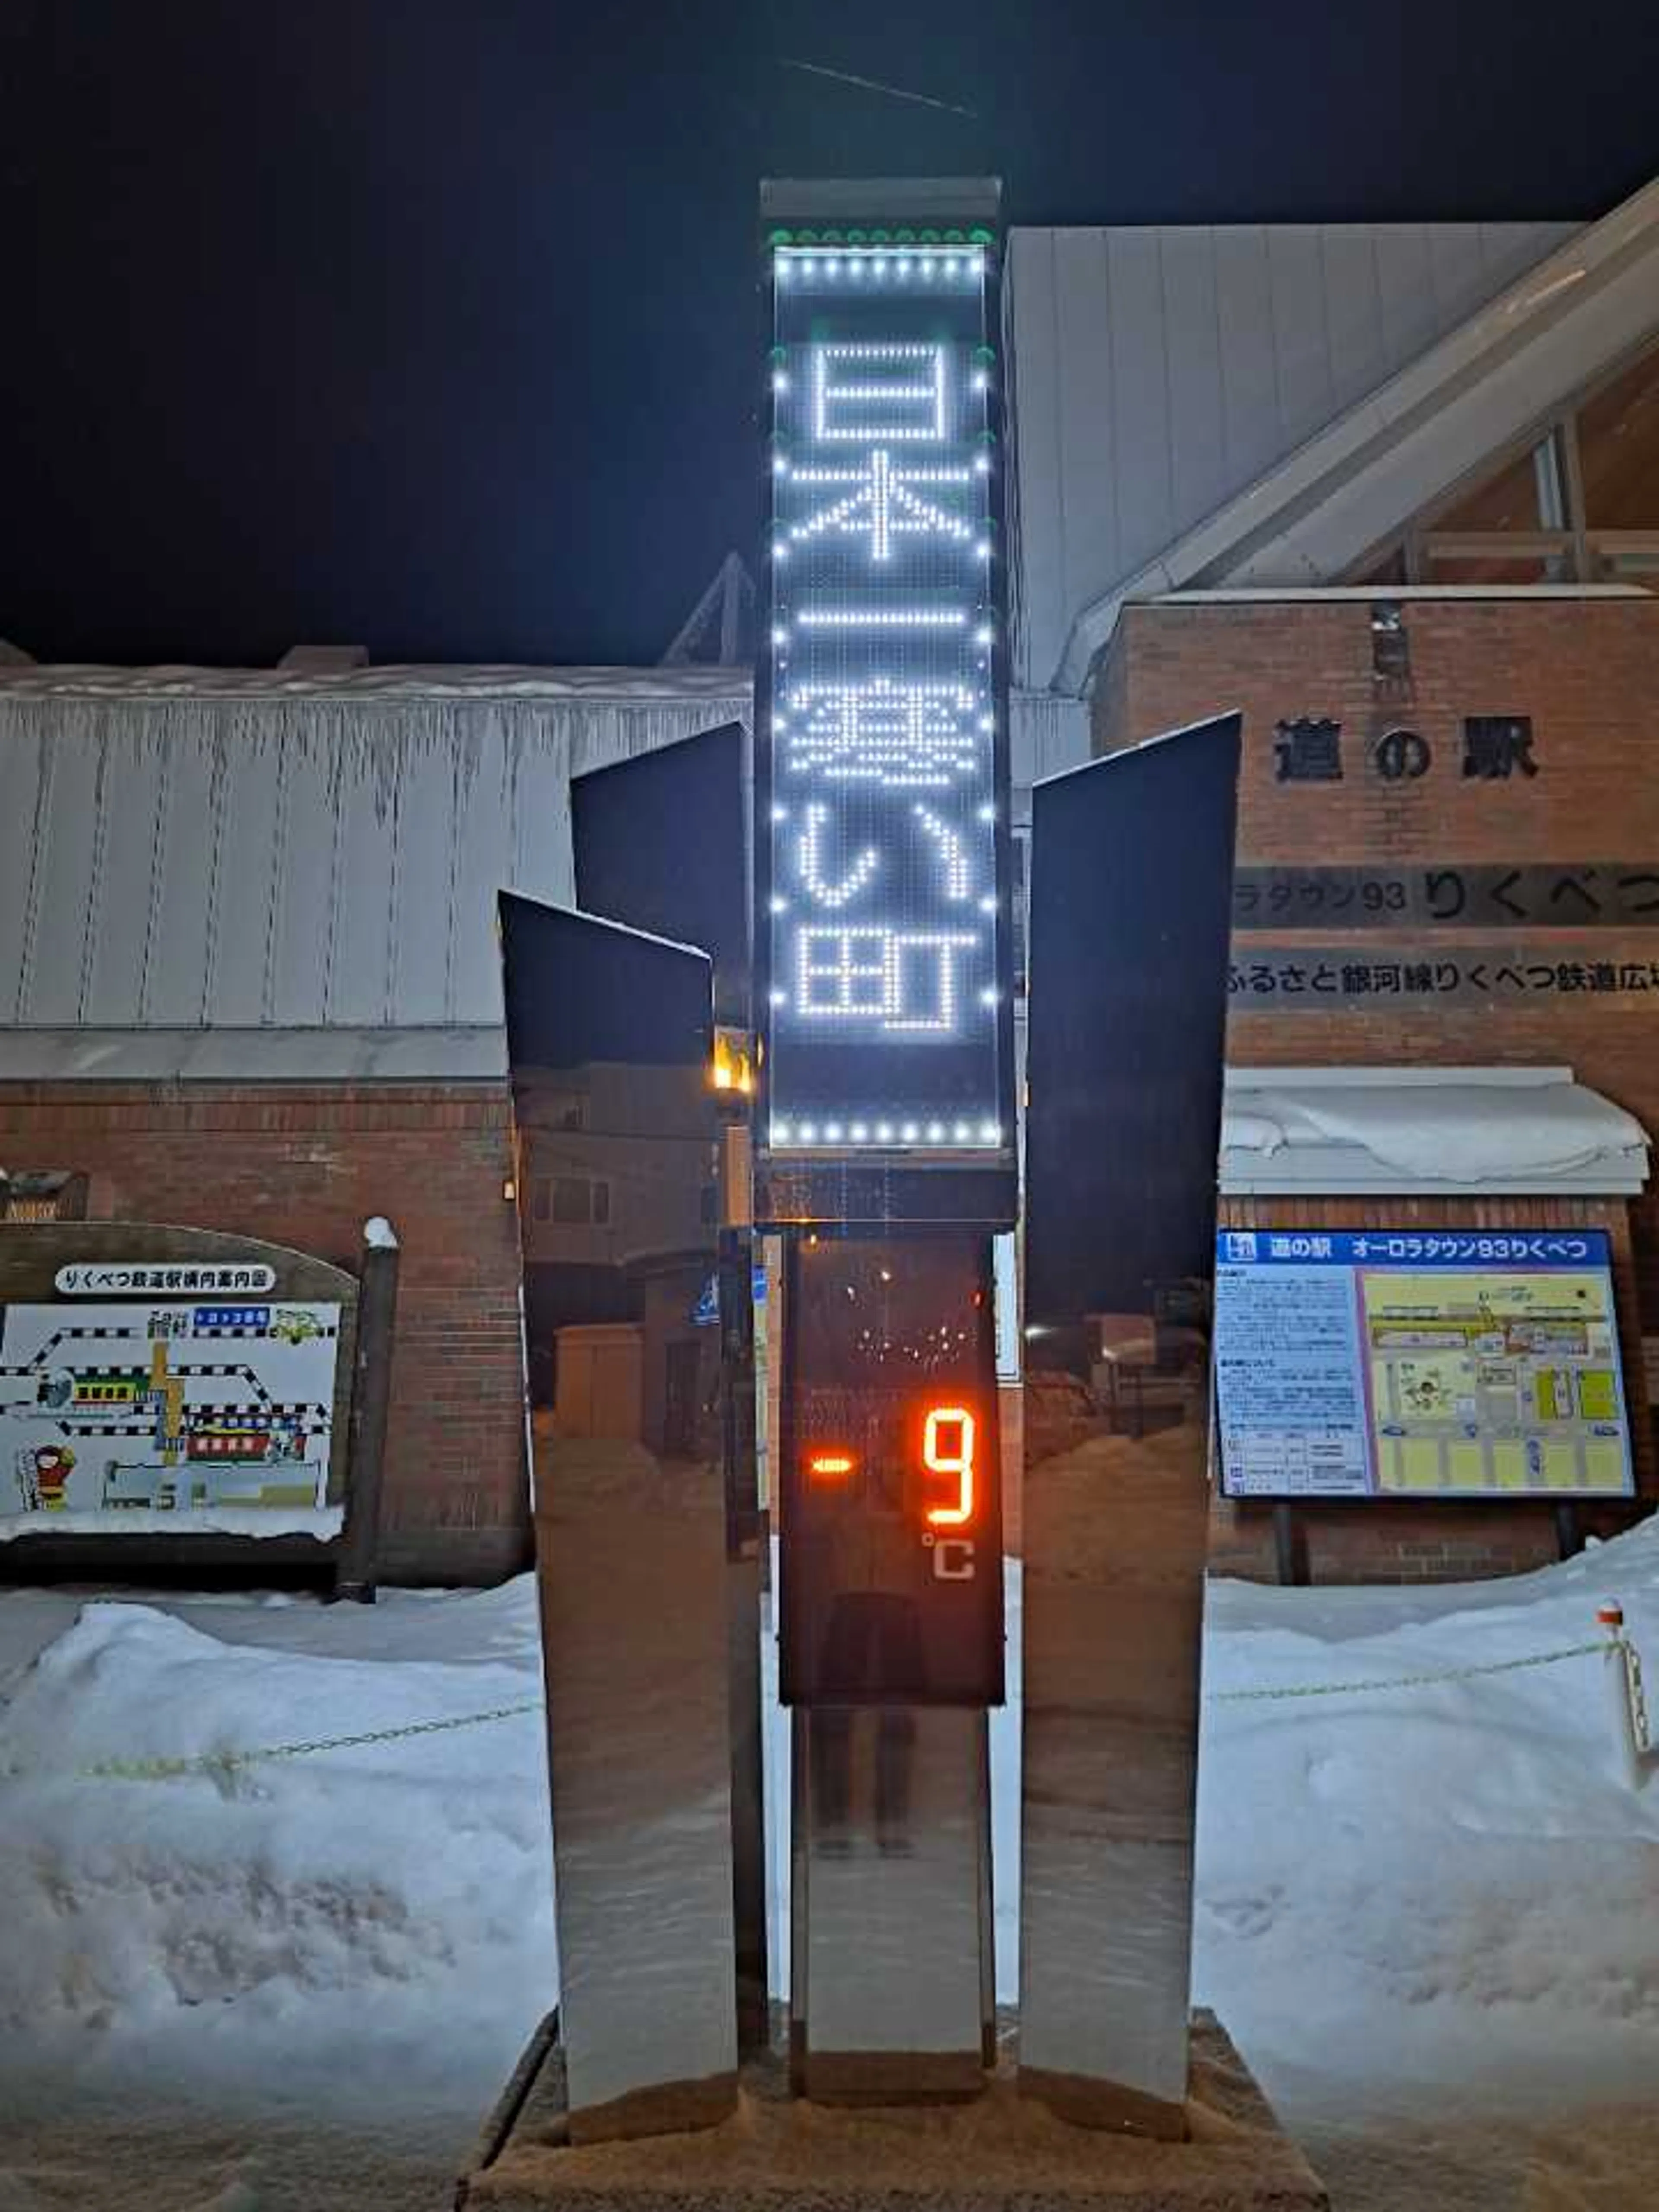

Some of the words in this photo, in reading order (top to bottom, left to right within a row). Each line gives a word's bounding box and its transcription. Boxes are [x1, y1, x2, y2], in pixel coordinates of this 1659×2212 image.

[788, 343, 979, 1033] 日本一寒い町
[1274, 716, 1539, 782] 道の駅
[1425, 870, 1659, 919] りくべつ
